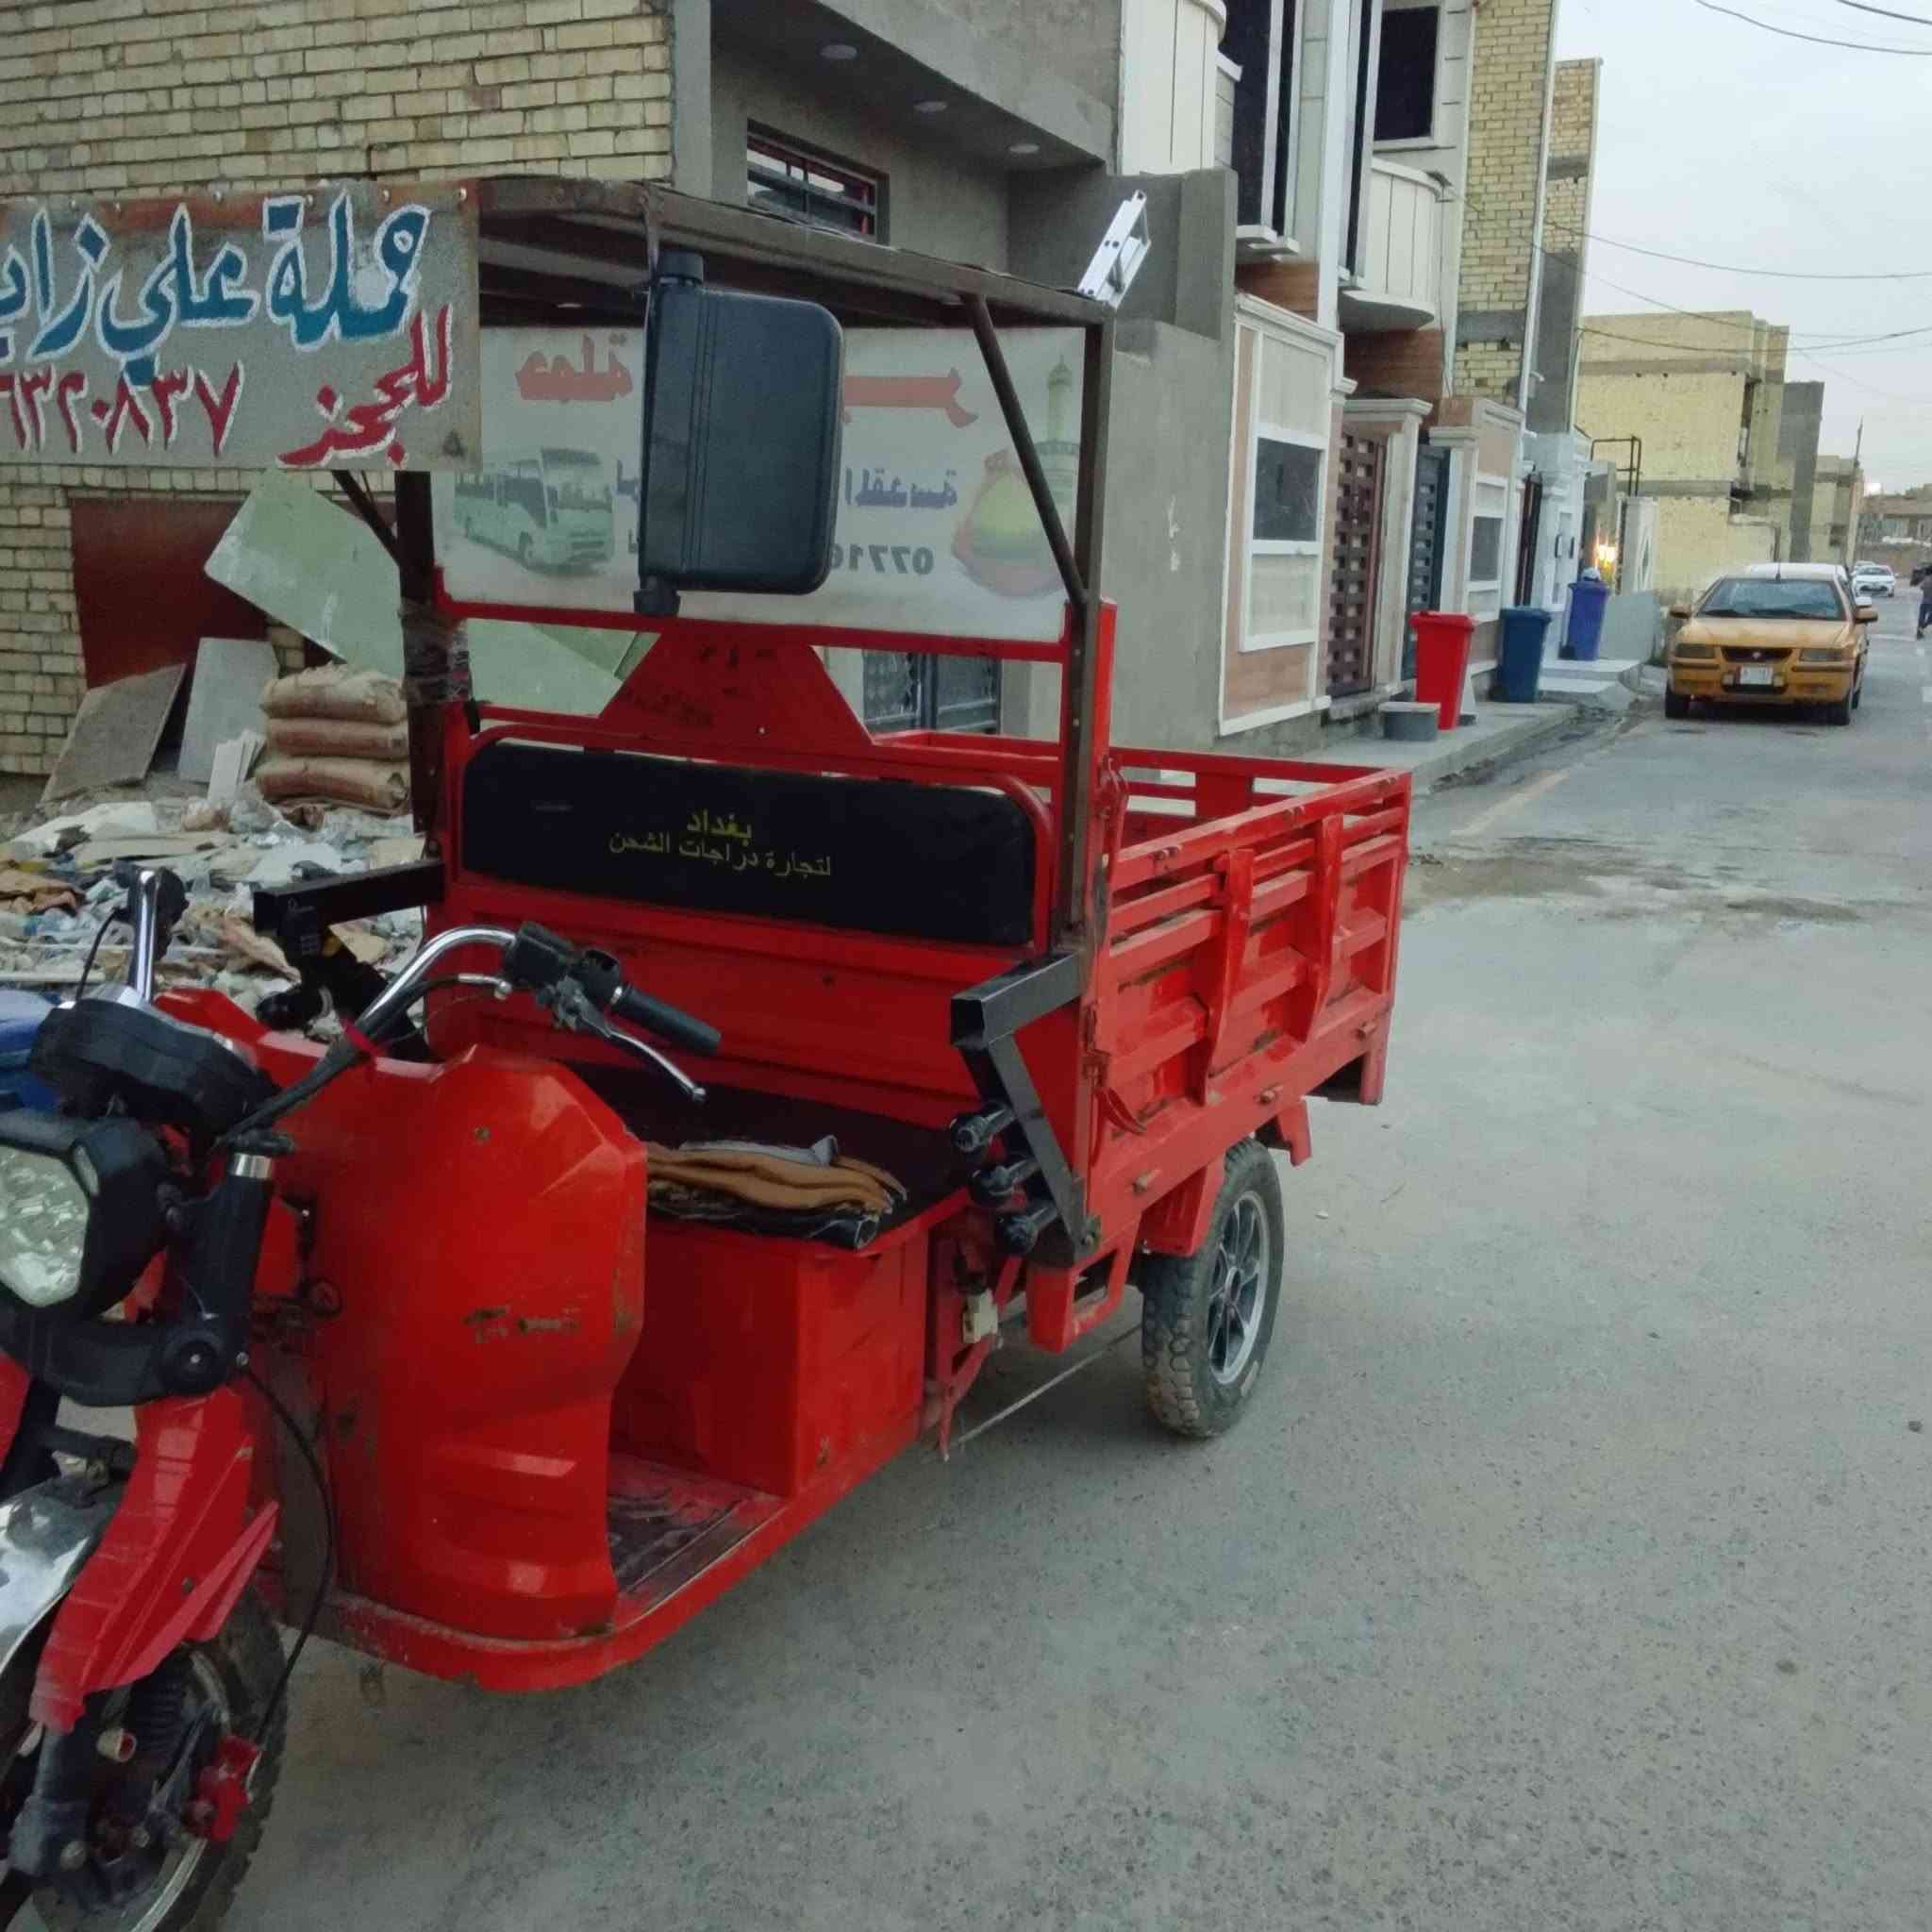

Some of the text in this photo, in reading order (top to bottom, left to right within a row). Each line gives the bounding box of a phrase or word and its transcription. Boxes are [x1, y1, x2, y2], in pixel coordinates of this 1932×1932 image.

[276, 303, 452, 469] للحجز
[686, 808, 752, 846] بغداد
[608, 830, 832, 878] لتجارة دراجات الشحن
